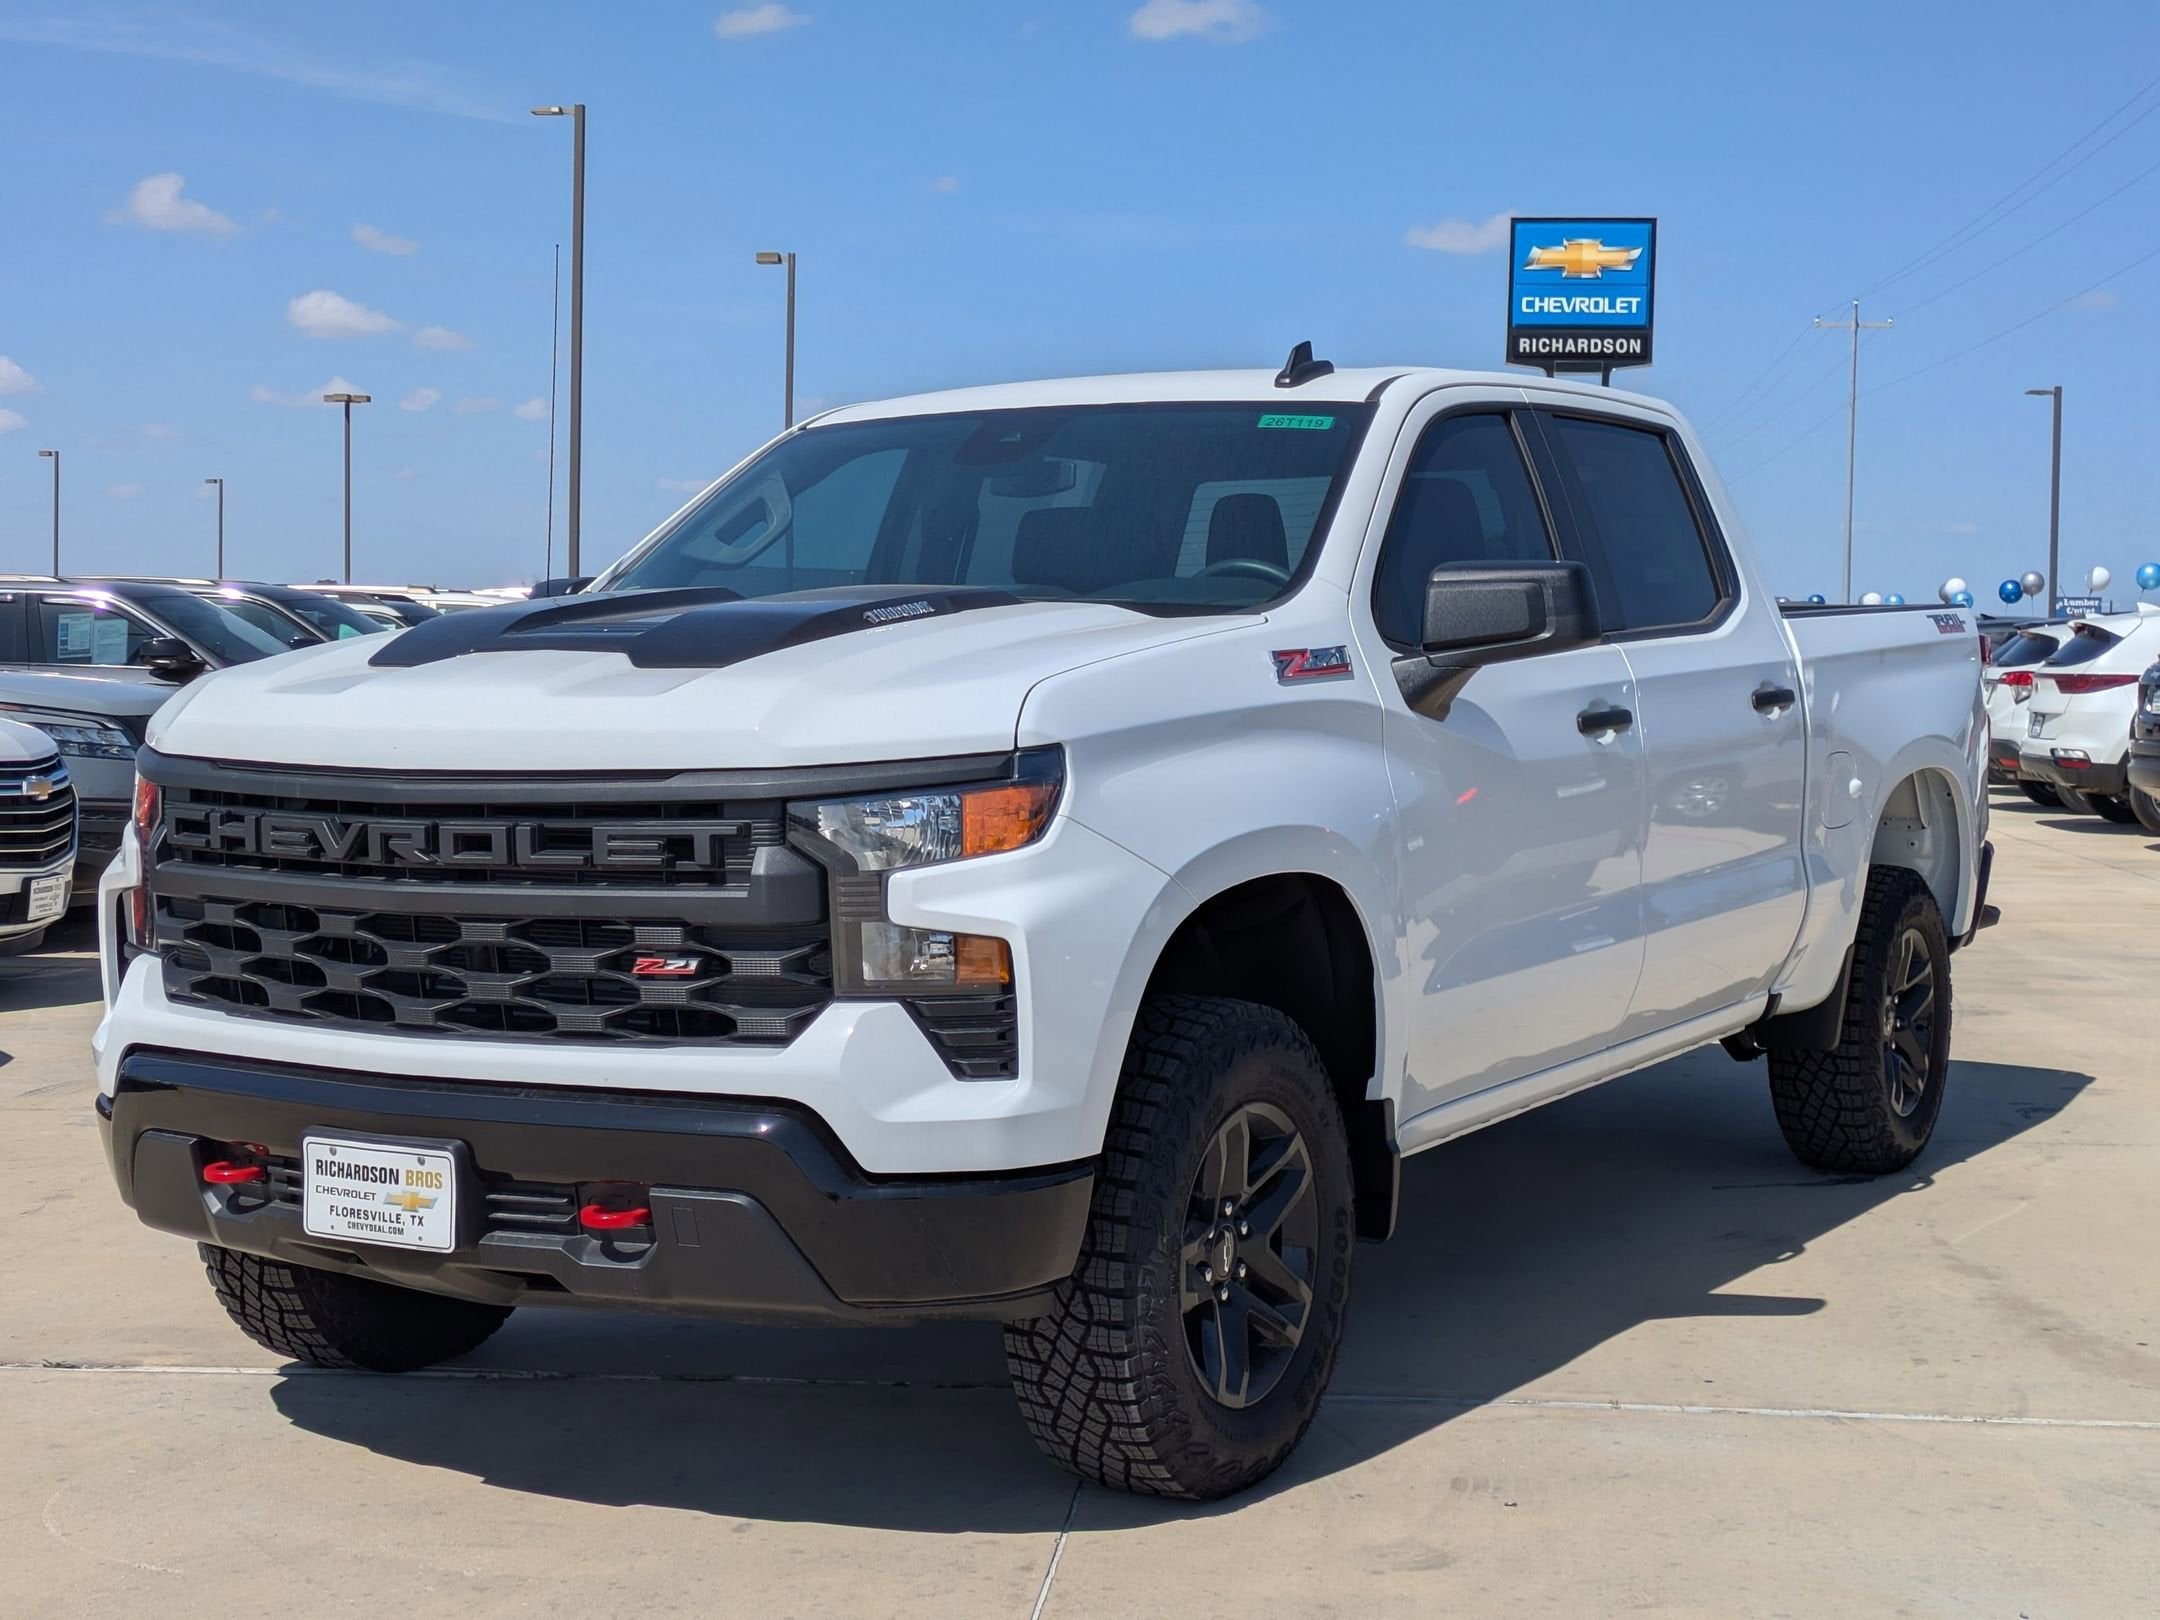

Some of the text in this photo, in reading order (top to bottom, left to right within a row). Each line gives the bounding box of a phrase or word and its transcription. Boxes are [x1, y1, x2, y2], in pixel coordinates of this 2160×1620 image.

[1521, 297, 1641, 314] CHEVROLET
[1519, 338, 1641, 353] RICHARDSON
[1265, 417, 1324, 428] 26T119
[2063, 598, 2100, 607] Lumber
[1926, 614, 1966, 625] TRAIL
[165, 806, 753, 868] CHEVROLET
[632, 957, 700, 975] Z71
[315, 1159, 443, 1189] RICHARDSON BROS
[315, 1184, 377, 1201] CHEVROLET
[329, 1205, 424, 1227] FLORESVILLE, TX
[347, 1221, 404, 1235] CHEVYDEAL.COM
